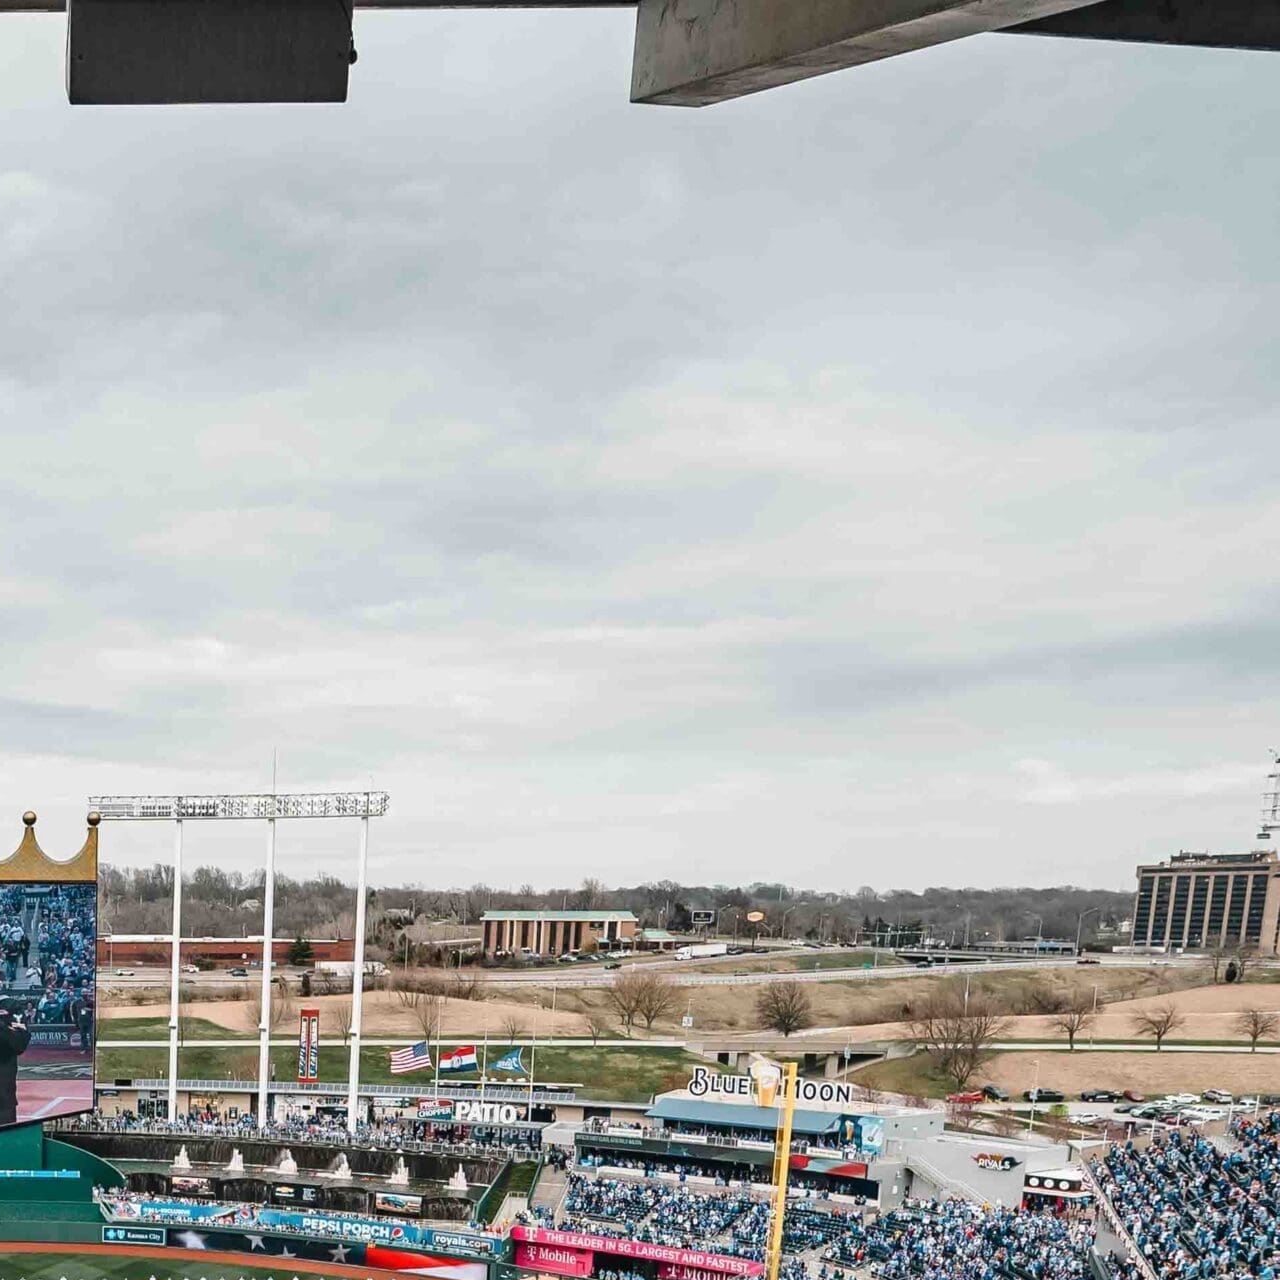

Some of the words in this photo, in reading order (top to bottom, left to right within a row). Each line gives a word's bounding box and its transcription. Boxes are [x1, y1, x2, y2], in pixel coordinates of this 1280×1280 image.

[689, 1068, 749, 1096] BLUE
[418, 1108, 452, 1118] CHOPPER
[456, 1102, 517, 1124] PATIO
[978, 1158, 1011, 1170] RIVALS
[302, 1217, 342, 1232] PEPSI
[343, 1222, 389, 1239] PORCH
[435, 1234, 492, 1252] royals.com
[545, 1232, 565, 1243] THE
[566, 1236, 604, 1249] LEADER
[605, 1240, 616, 1249] IN
[617, 1243, 634, 1253] 5G.
[635, 1244, 679, 1261] LARGEST
[681, 1253, 704, 1264] AND
[539, 1247, 576, 1264] Mobile
